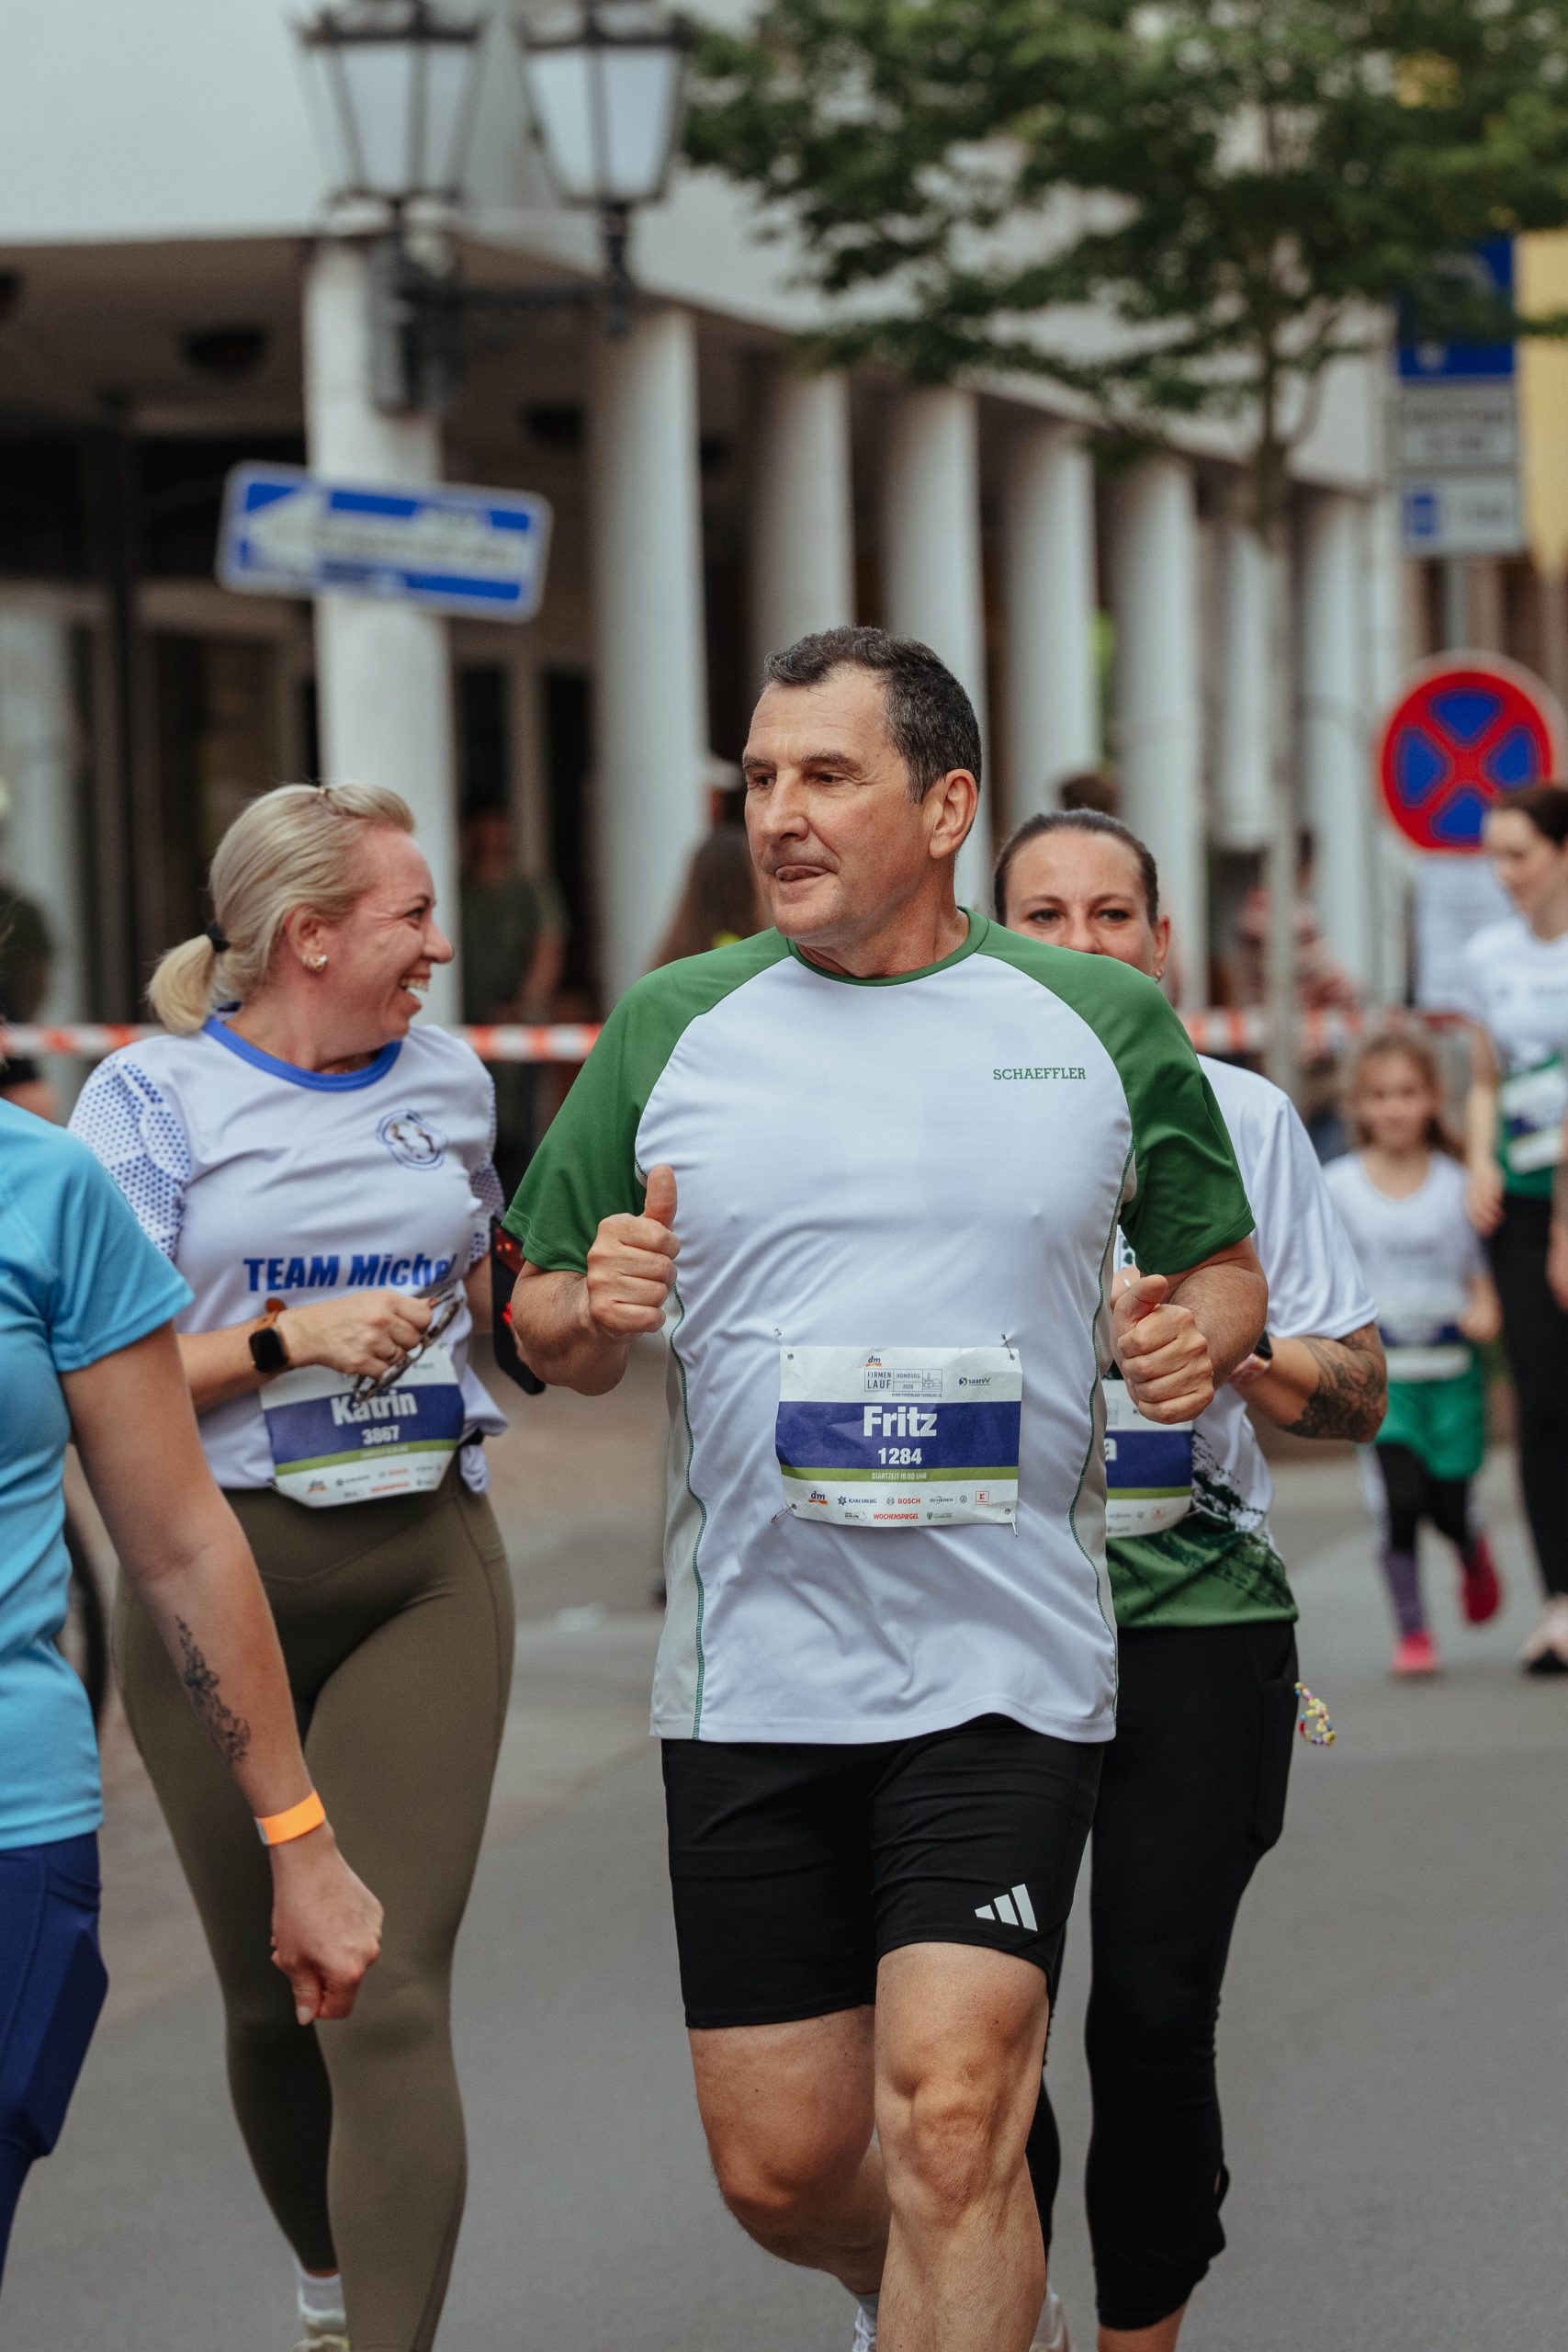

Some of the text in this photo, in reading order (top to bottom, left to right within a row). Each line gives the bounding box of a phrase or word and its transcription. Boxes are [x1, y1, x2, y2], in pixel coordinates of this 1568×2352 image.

[993, 1068, 1086, 1080] SCHAEFFLER
[243, 1255, 339, 1292] TEAM
[867, 1380, 891, 1389] LAUF
[331, 1389, 419, 1426] Katrin
[863, 1406, 938, 1437] Fritz
[361, 1425, 400, 1446] 3867
[878, 1448, 922, 1464] 1284
[811, 1491, 826, 1500] dm
